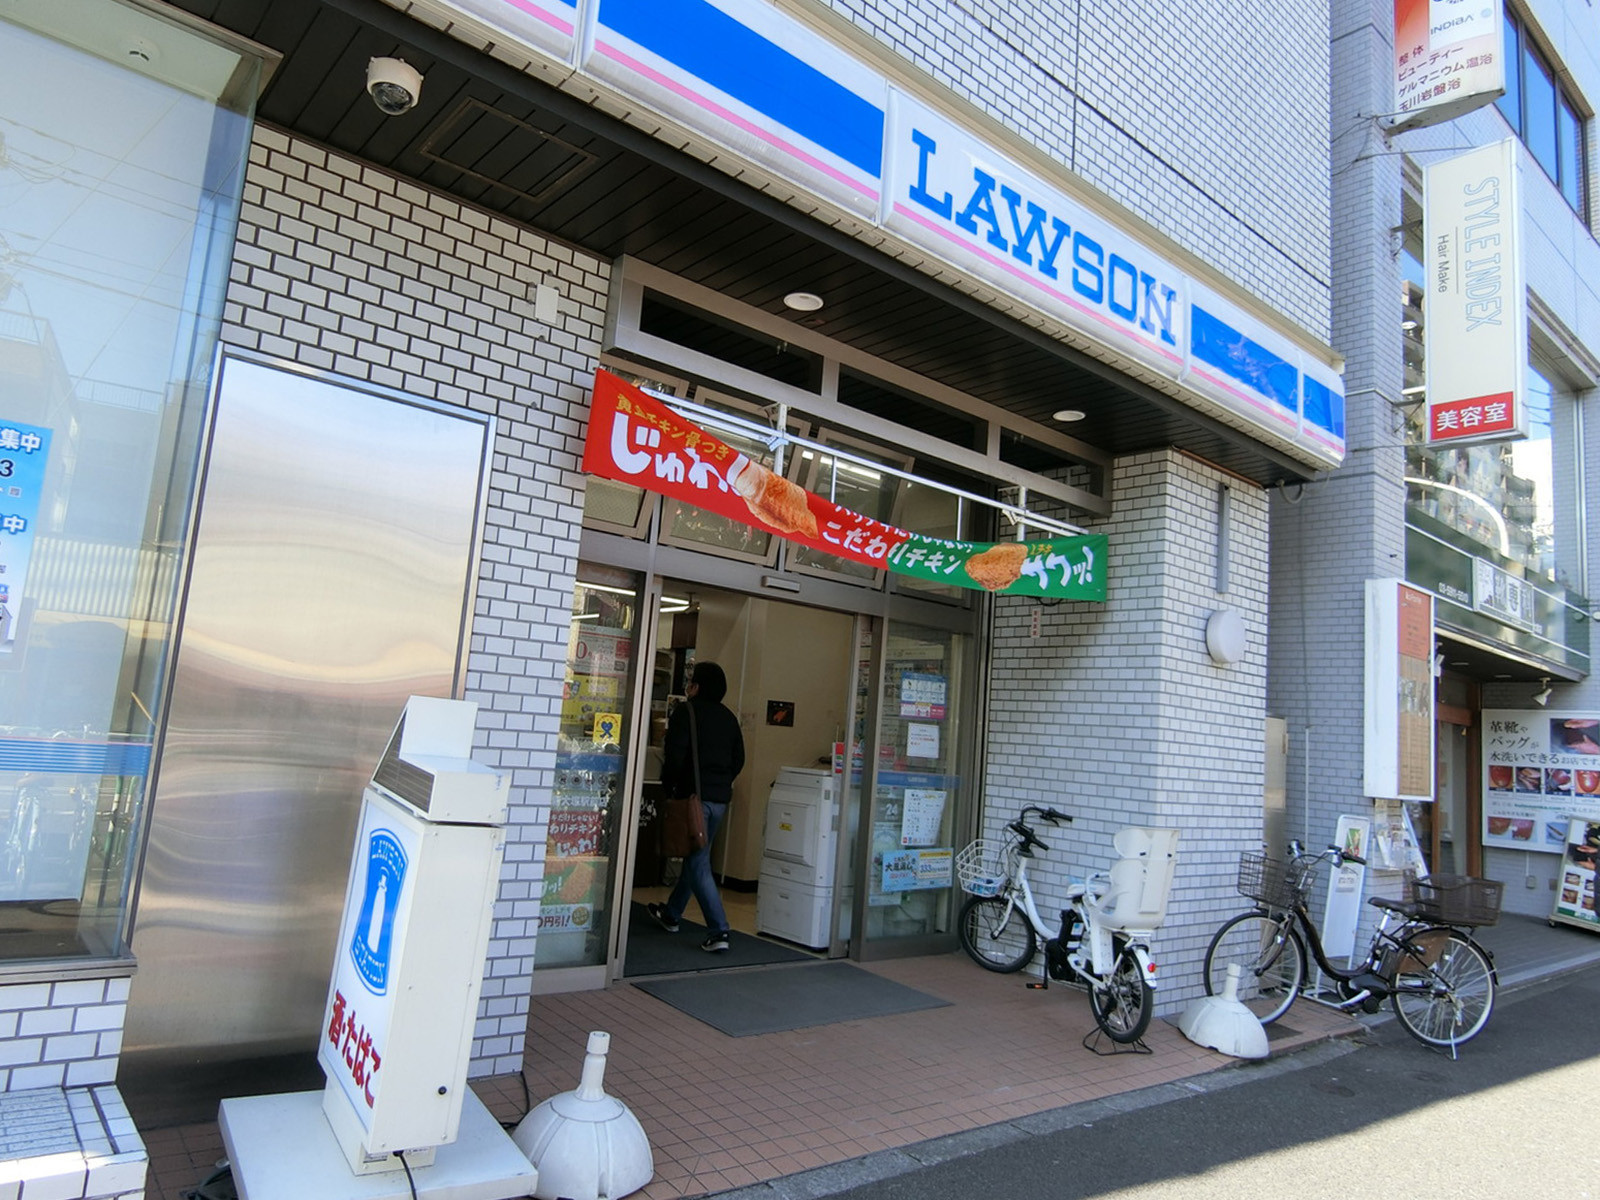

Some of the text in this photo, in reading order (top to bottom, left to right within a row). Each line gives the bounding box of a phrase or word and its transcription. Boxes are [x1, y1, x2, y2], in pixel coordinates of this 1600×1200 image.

[1431, 14, 1474, 35] INDIBA
[1398, 47, 1464, 82] ビューティー
[1398, 54, 1493, 97] ゲルマニウム温浴
[1399, 78, 1461, 111] 玉川岩盤浴
[908, 128, 1177, 347] LAWSON
[1463, 176, 1502, 333] STYLE INDEX
[1437, 234, 1449, 293] Hair Make
[1436, 402, 1507, 432] 美容室
[822, 520, 962, 575] こだわりチキン
